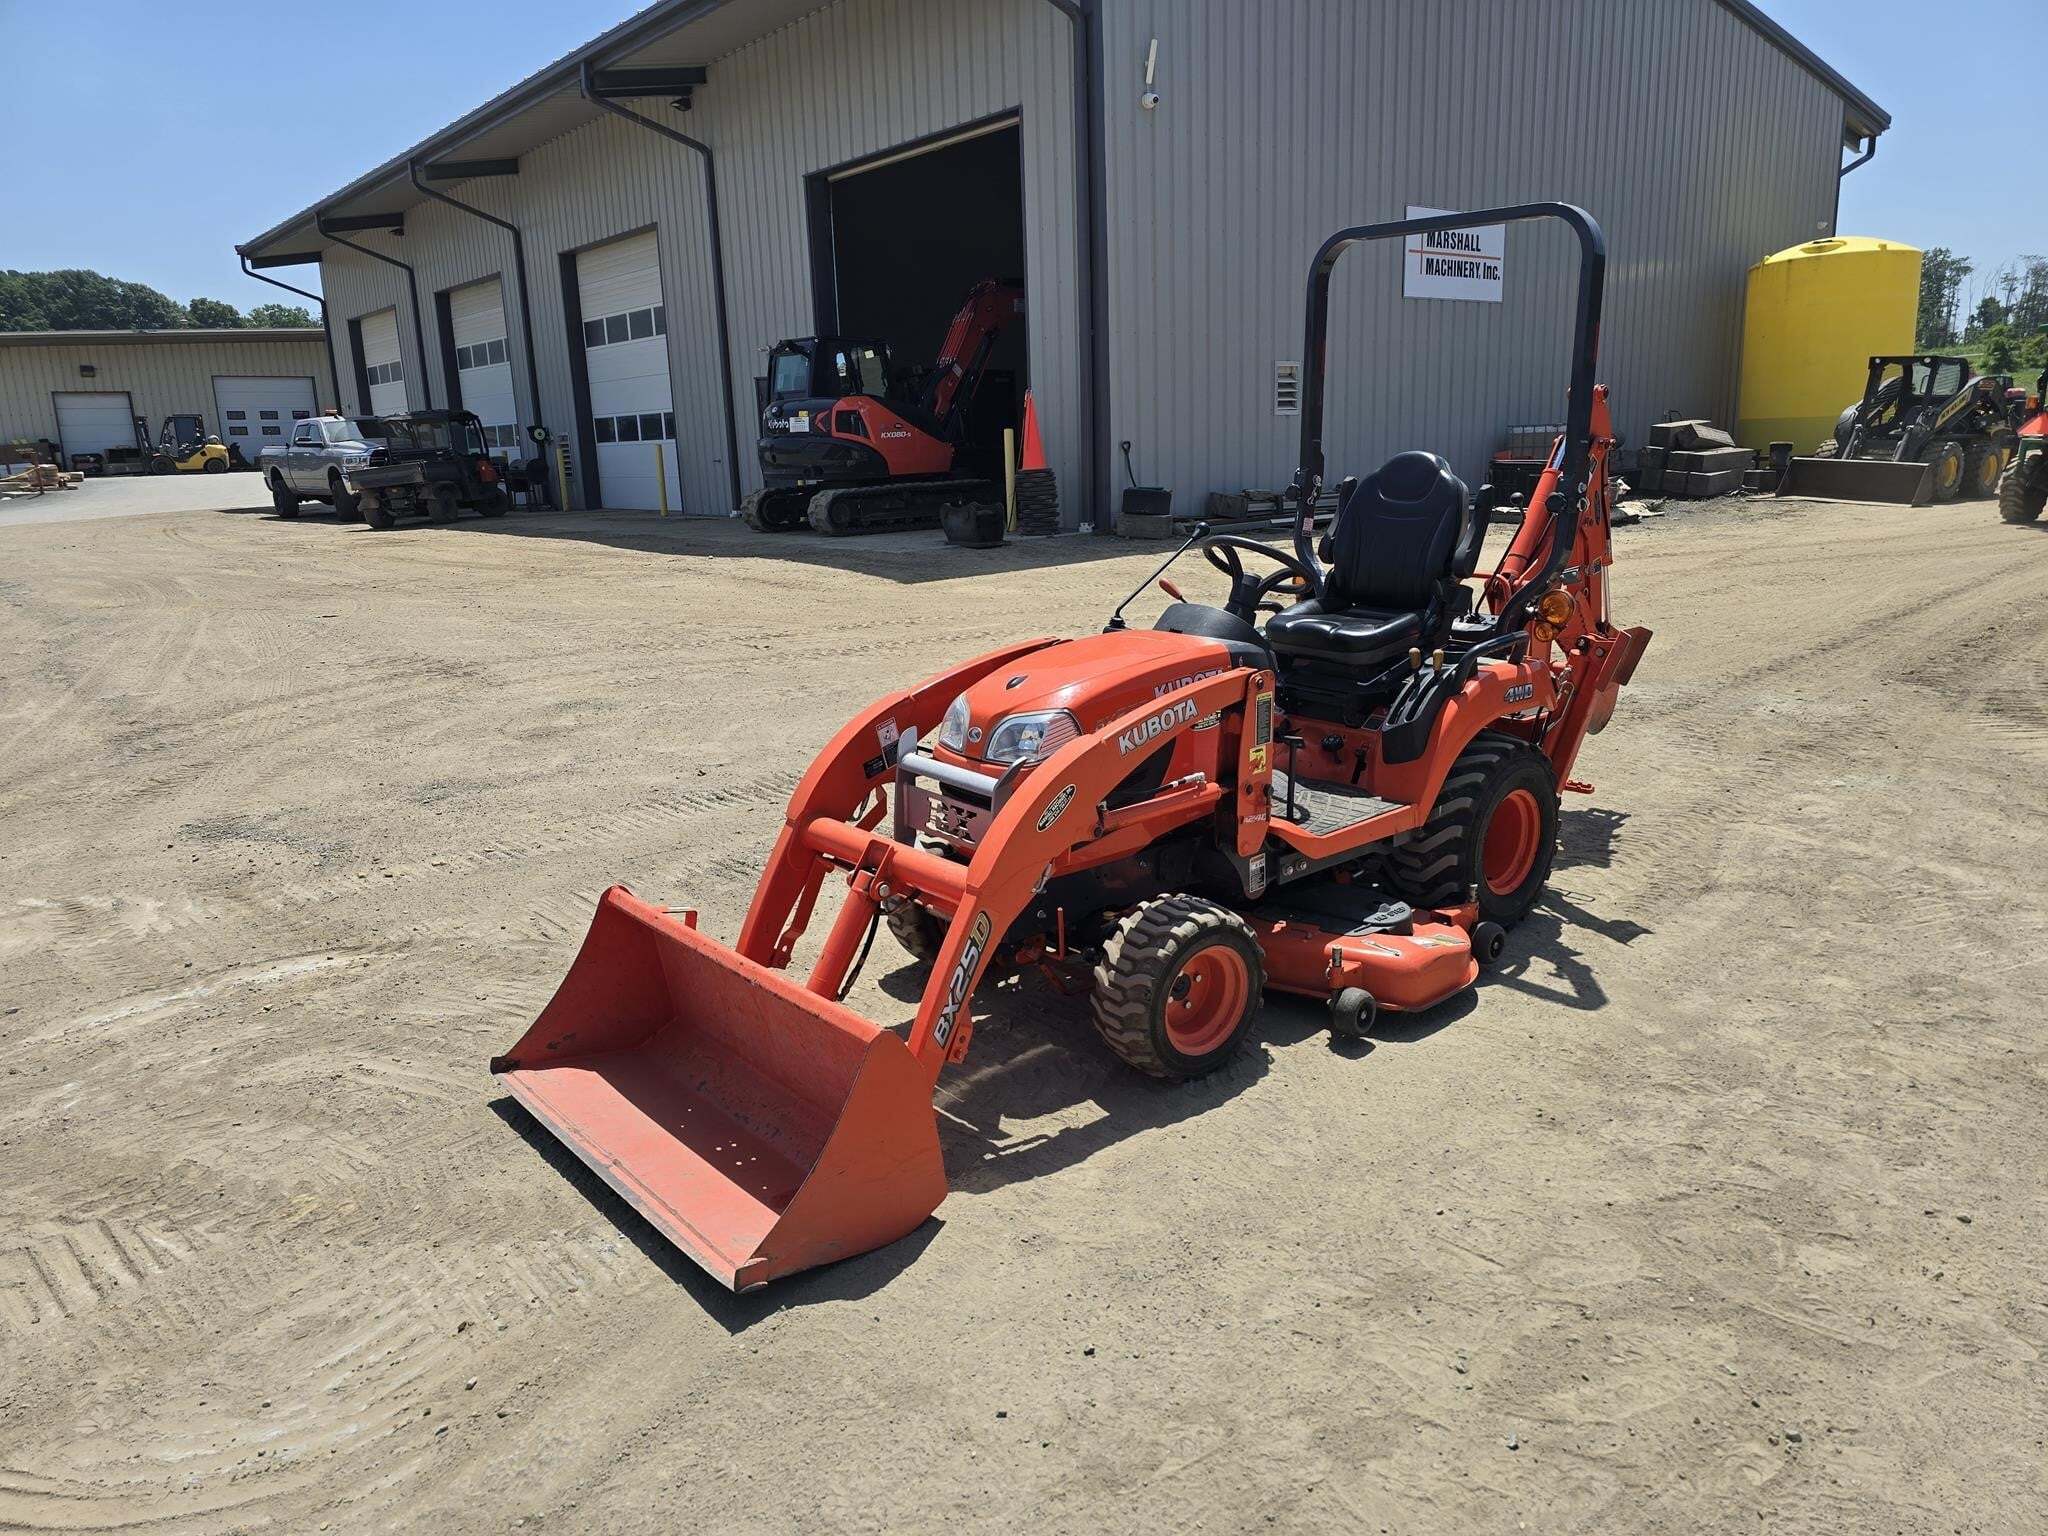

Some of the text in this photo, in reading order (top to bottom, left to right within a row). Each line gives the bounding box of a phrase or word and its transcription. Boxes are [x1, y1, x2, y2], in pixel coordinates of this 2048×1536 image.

[1426, 231, 1481, 252] MARSHALL
[1483, 261, 1501, 281] Inc.
[1504, 683, 1533, 703] 4WD
[1118, 698, 1198, 757] KUBOTA
[933, 911, 993, 1050] BX25D
